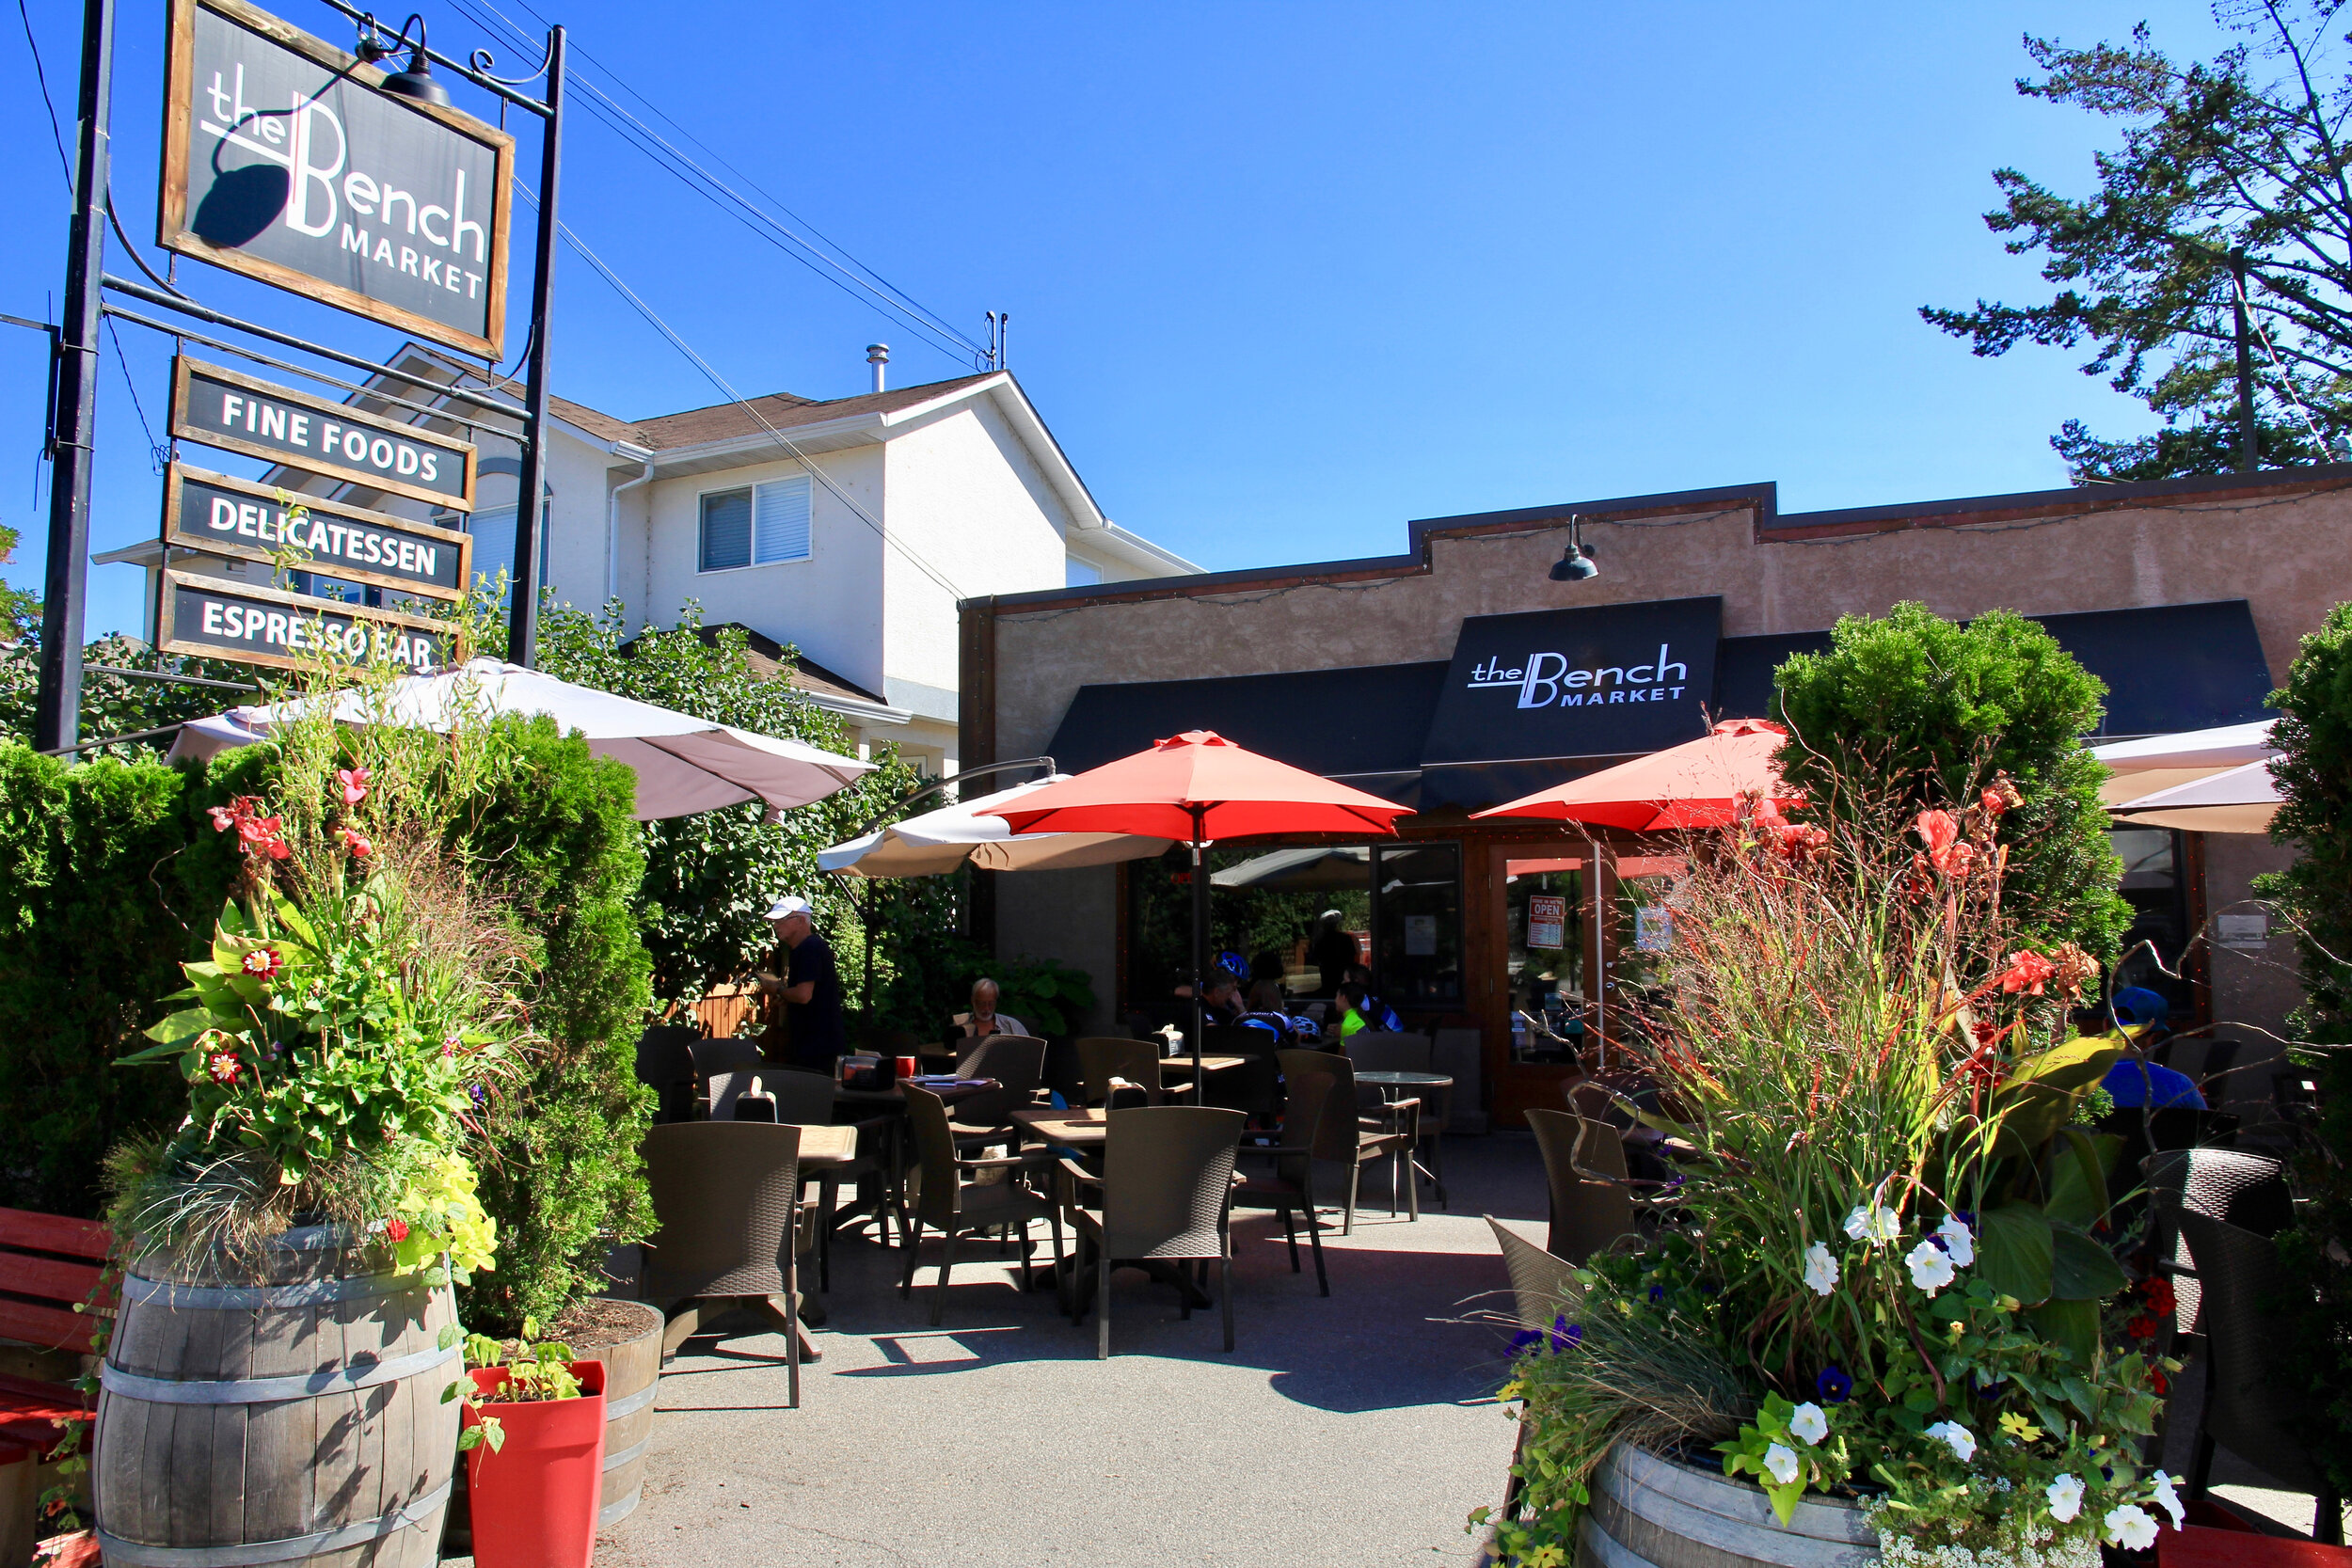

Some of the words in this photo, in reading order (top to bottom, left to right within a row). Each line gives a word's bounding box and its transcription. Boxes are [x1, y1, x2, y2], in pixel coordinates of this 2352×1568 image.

[206, 62, 287, 145] the
[285, 90, 485, 264] Bench
[341, 223, 483, 300] MARKET
[221, 393, 310, 448] FINE
[322, 422, 438, 483] FOODS
[210, 497, 437, 577] DELICATESSEN
[201, 600, 367, 657] ESPRESSO
[374, 631, 432, 668] BAR
[1470, 656, 1523, 682] the
[1517, 643, 1688, 709] Bench
[1560, 686, 1686, 707] MARKET
[1534, 903, 1560, 916] OPEN
